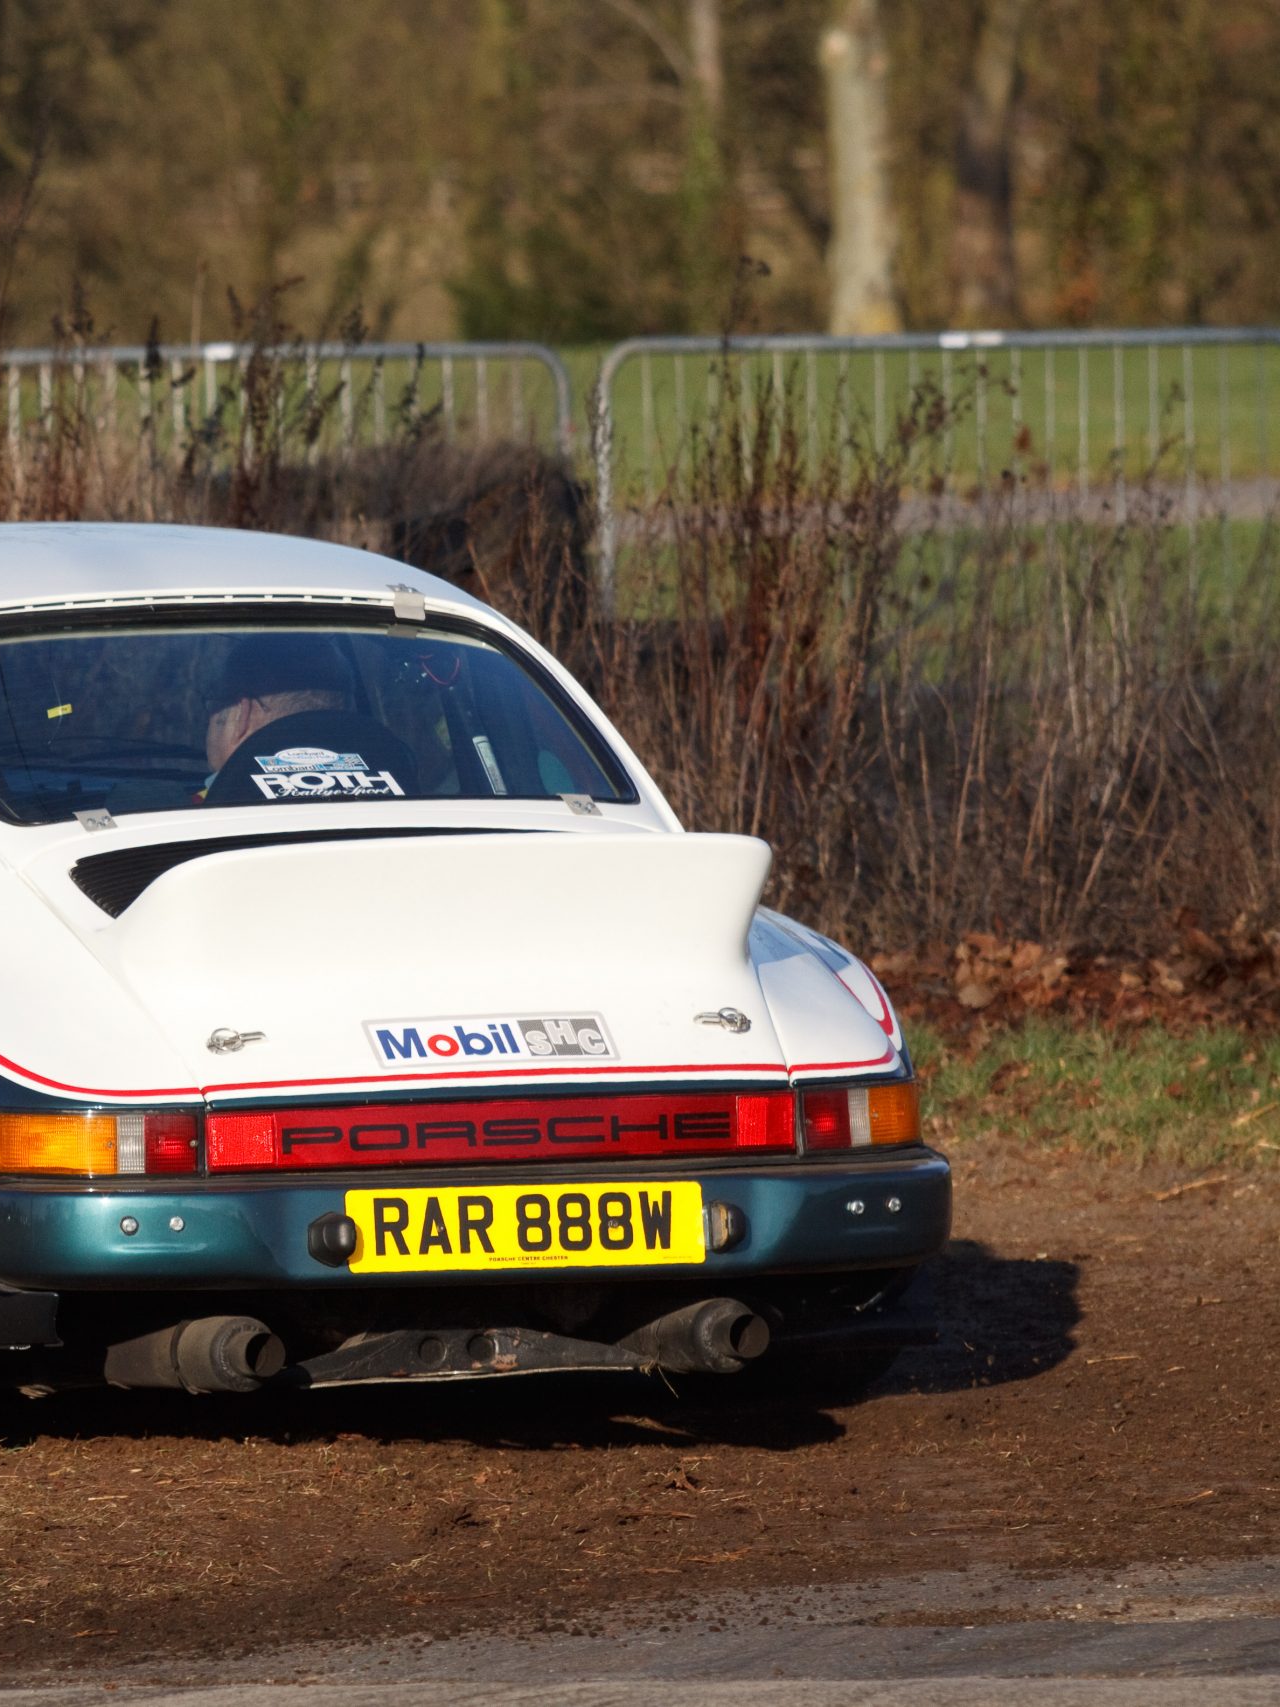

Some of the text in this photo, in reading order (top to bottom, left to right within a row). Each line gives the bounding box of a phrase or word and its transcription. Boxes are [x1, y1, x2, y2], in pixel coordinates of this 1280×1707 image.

[251, 771, 405, 799] ROTH
[376, 1020, 606, 1060] Mobil SHC
[282, 1112, 730, 1154] PORSCHE
[373, 1190, 672, 1256] RAR 888W
